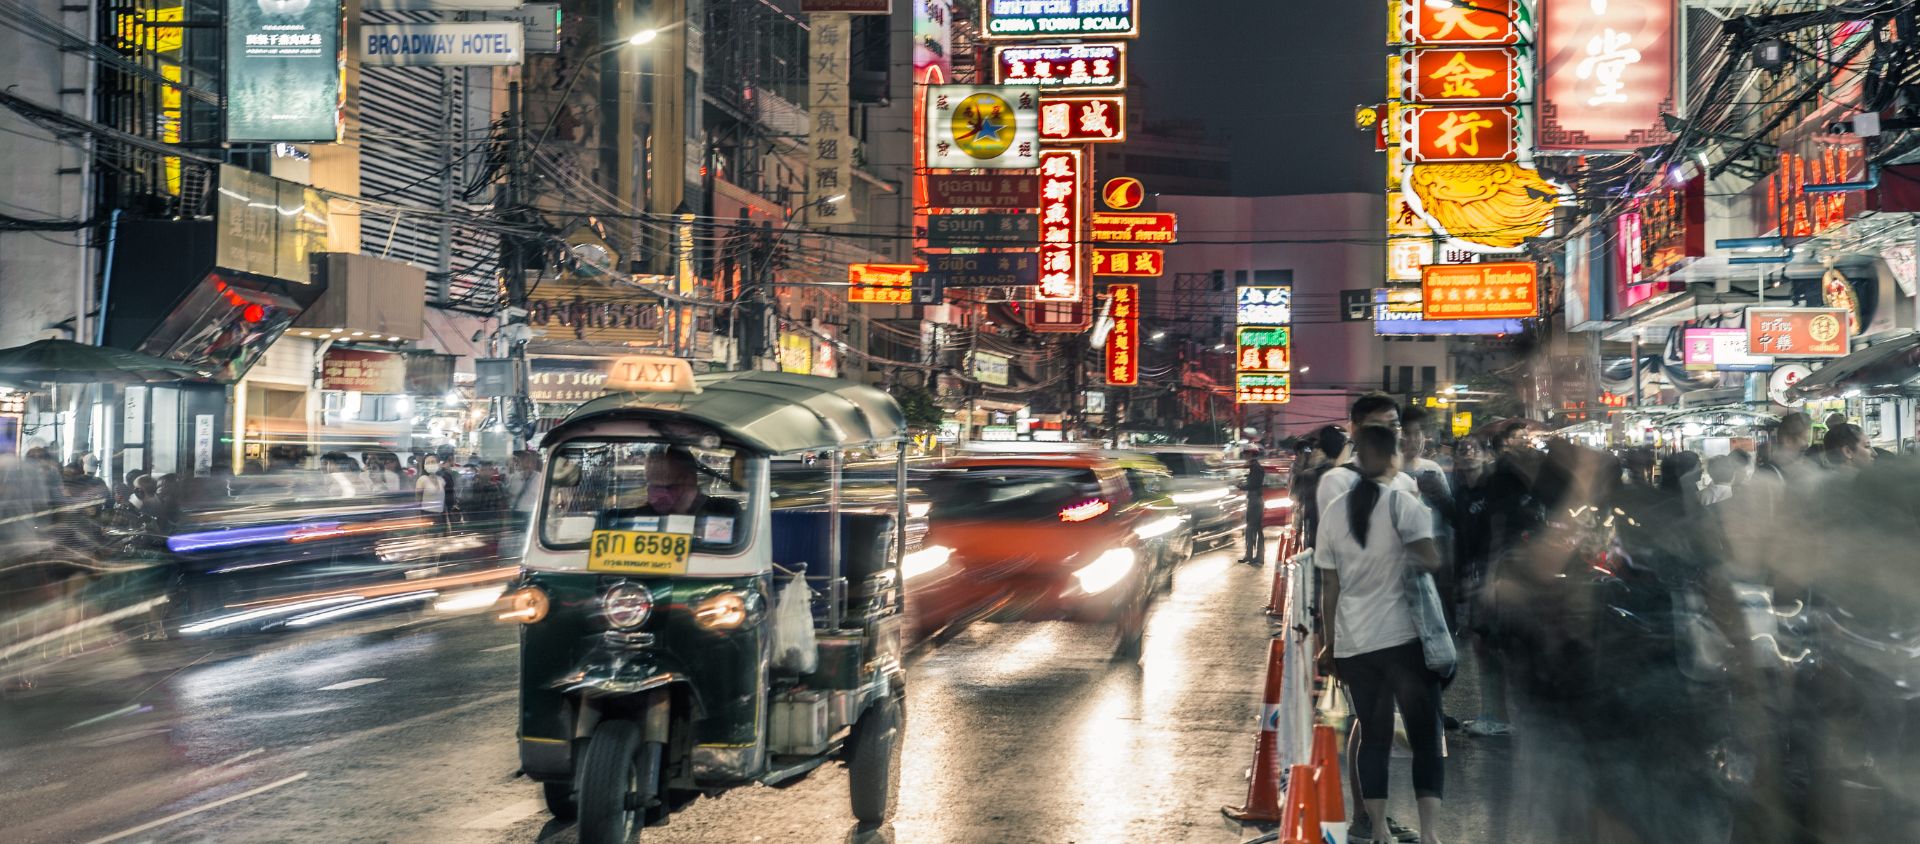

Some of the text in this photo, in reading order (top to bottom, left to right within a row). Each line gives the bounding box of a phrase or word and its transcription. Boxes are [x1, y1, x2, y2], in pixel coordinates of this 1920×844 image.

[990, 16, 1130, 32] CHINA TOWN SCALA
[367, 33, 512, 55] BROADWAY HOTEL
[938, 180, 992, 196] หูฉลาม
[949, 195, 1018, 205] SHARK FIN
[951, 275, 1016, 284] SEAFOOD
[622, 362, 676, 382] TAXI
[634, 534, 686, 558] 6598
